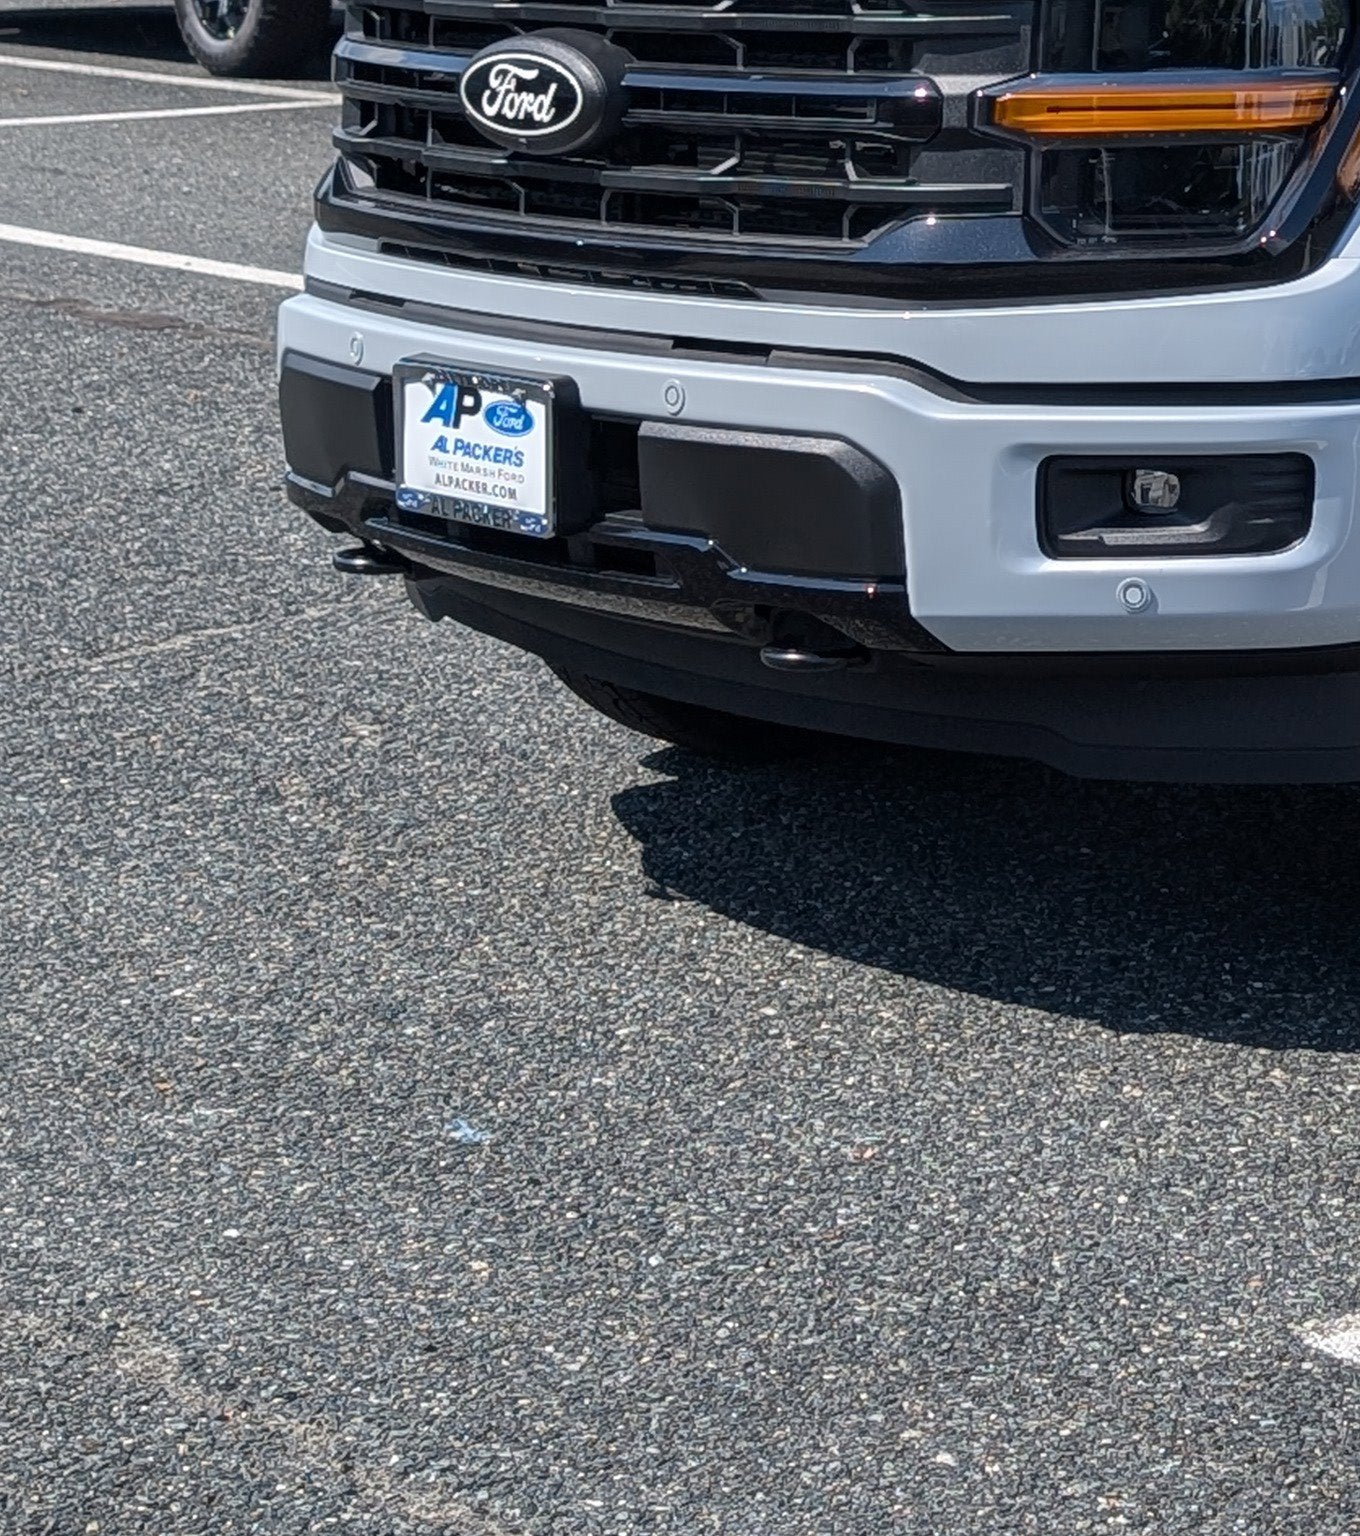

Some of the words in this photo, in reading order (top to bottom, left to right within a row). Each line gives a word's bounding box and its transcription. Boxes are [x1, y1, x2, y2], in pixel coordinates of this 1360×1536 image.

[481, 63, 558, 123] Ford
[421, 382, 482, 429] AP
[492, 406, 525, 431] Ford
[431, 435, 450, 453] AL
[453, 437, 525, 468] PACKER'S
[428, 456, 459, 472] WHITE
[460, 462, 496, 478] MARSH
[497, 468, 525, 485] FORD
[434, 473, 517, 500] ALPACKER.COM
[431, 495, 449, 517] AL
[453, 498, 512, 529] PACKER
